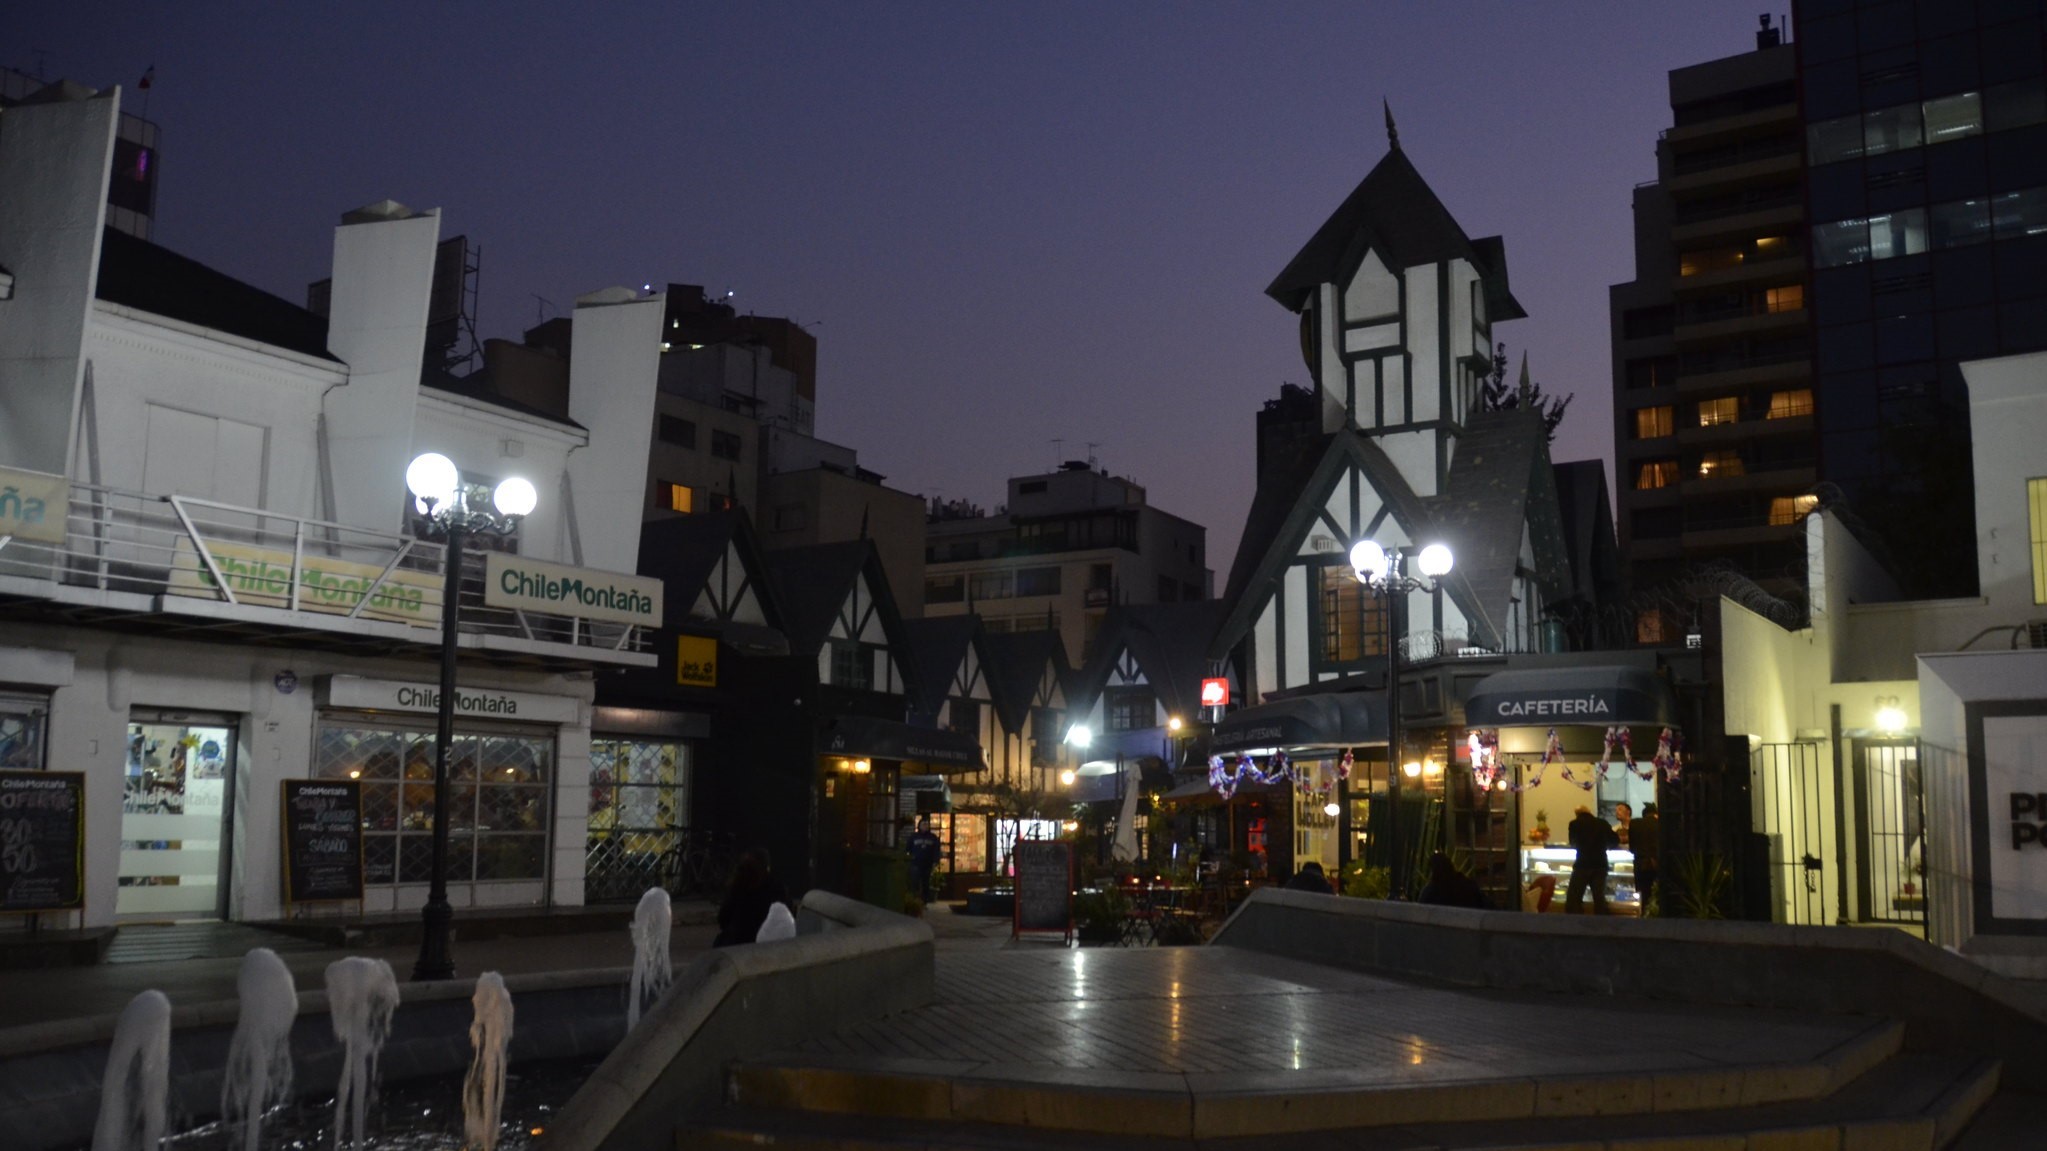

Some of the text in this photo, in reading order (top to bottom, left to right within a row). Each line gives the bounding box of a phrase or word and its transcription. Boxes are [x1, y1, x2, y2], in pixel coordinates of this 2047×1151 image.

[500, 569, 652, 615] ChileMontaña
[682, 661, 699, 672] Jack
[1497, 694, 1610, 717] CAFETERÍA
